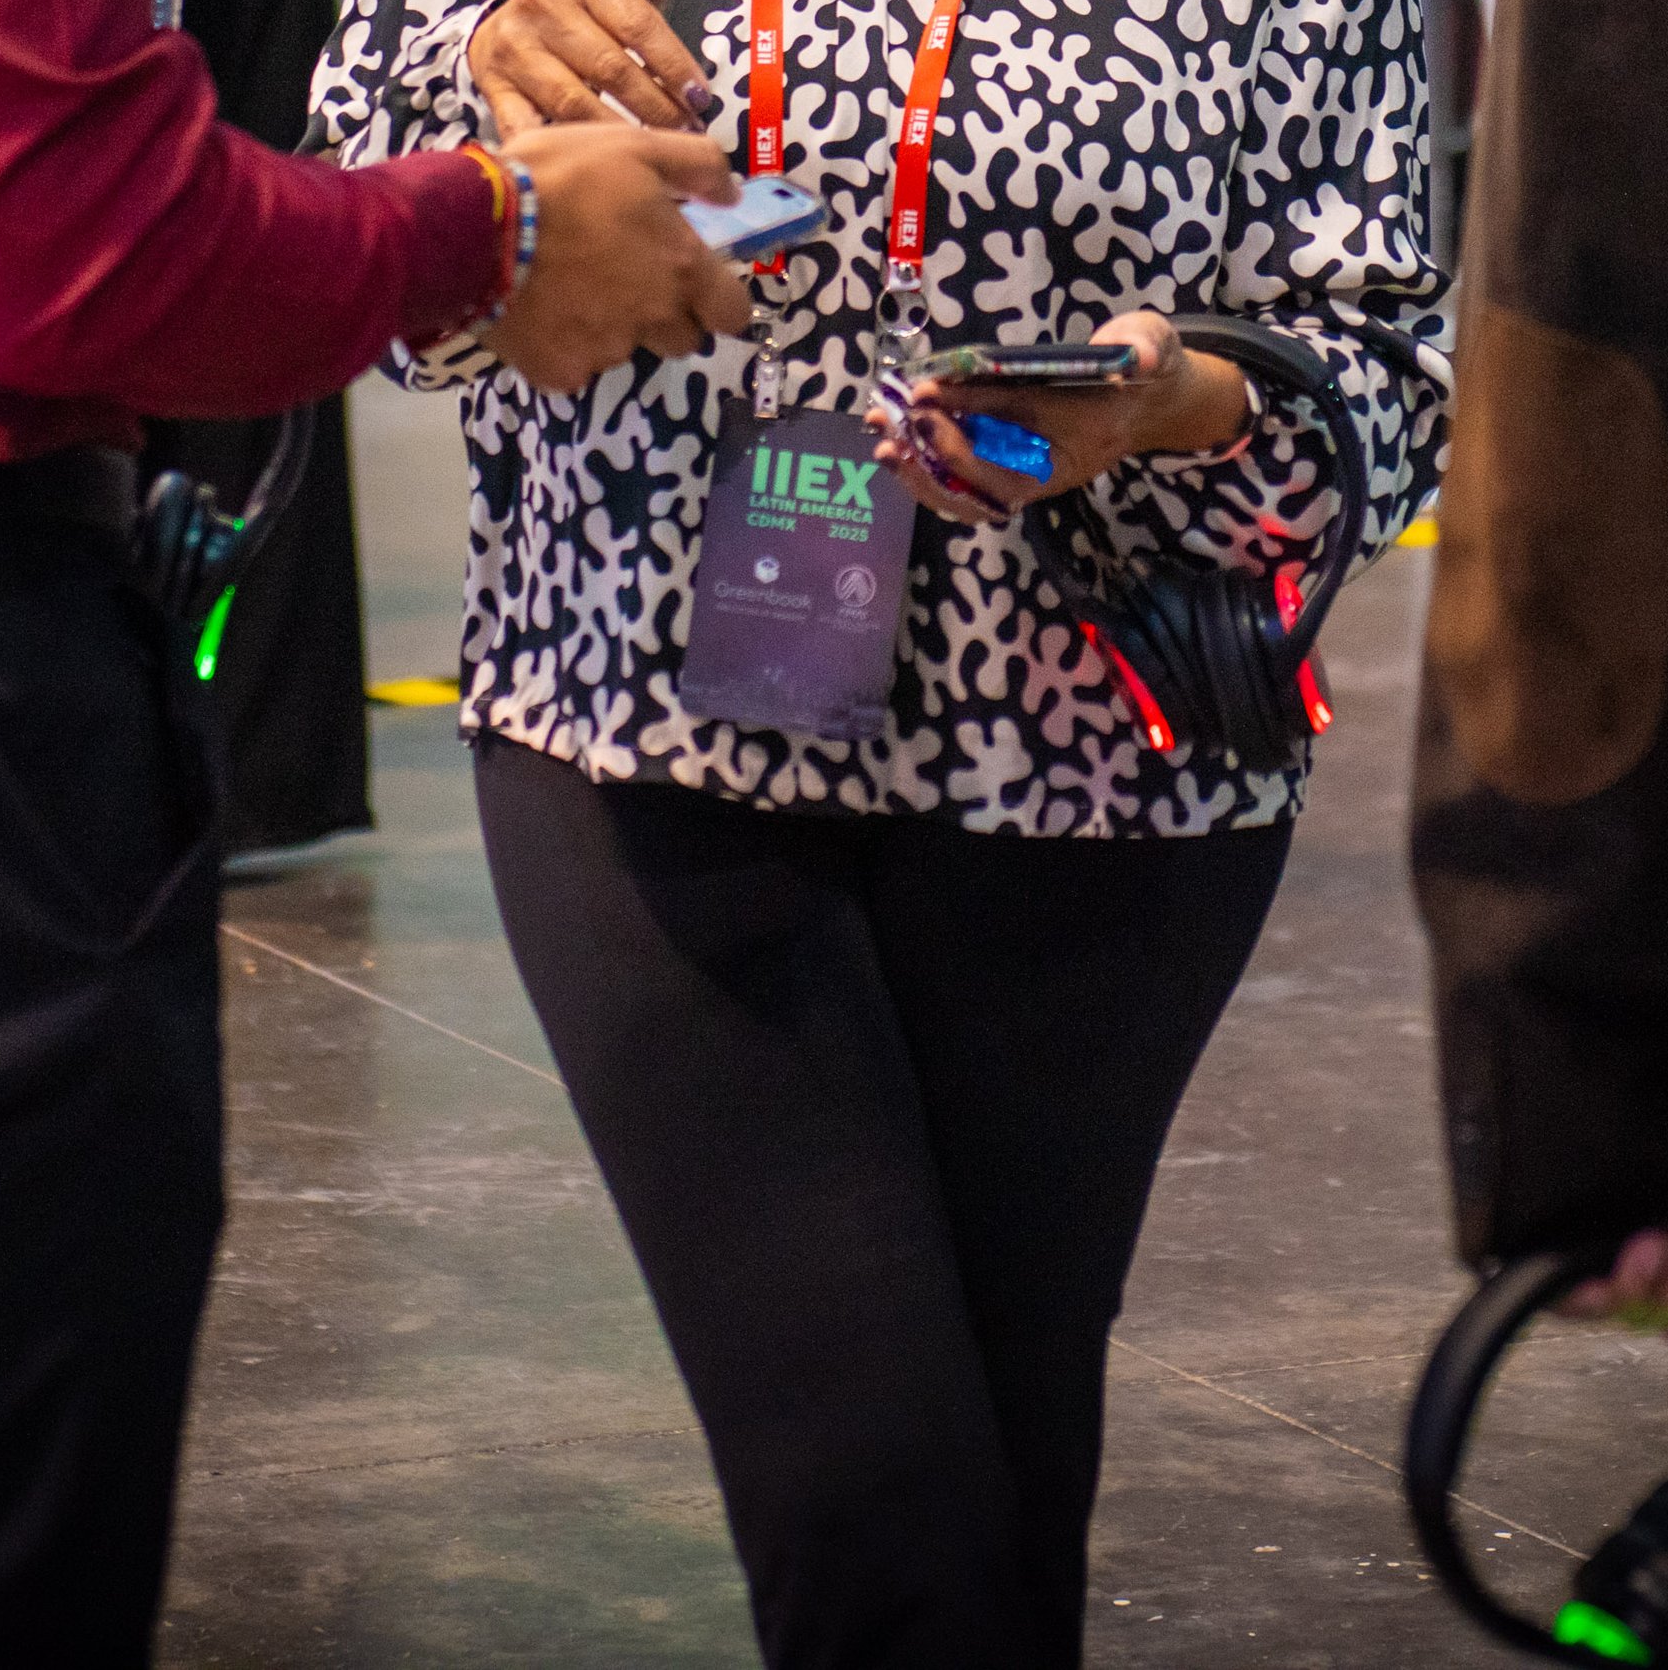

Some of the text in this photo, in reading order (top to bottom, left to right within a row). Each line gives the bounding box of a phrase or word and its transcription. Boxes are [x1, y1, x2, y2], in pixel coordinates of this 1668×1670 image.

[757, 29, 772, 65] IIEX
[931, 15, 951, 49] IIEX
[911, 108, 930, 145] IIEX
[756, 128, 772, 165] IIEX
[902, 209, 918, 248] IIEX
[751, 445, 880, 509] IIEX
[746, 511, 871, 543] CDMX 2025
[749, 494, 874, 524] LATIN AMERICA
